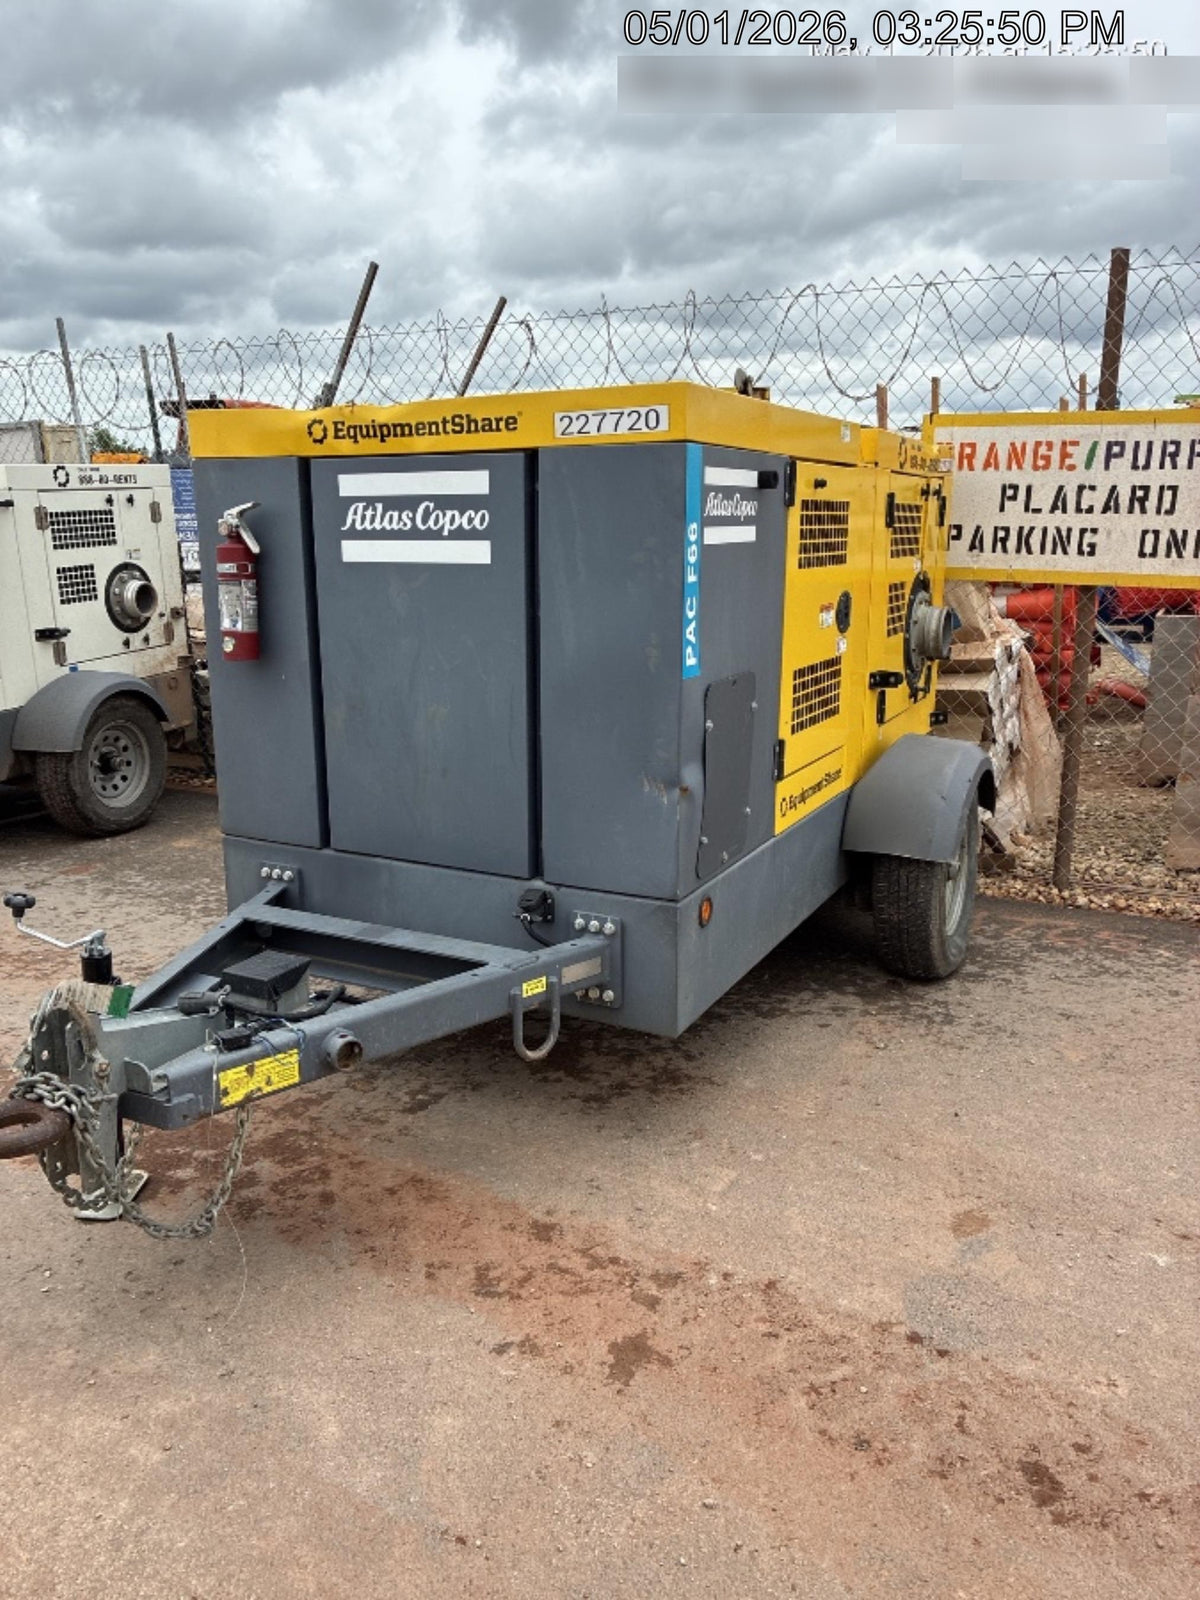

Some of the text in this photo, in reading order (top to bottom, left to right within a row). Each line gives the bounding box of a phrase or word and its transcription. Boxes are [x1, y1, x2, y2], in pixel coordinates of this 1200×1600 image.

[331, 413, 519, 444] EquipmentShare
[559, 408, 660, 436] 227720
[999, 483, 1179, 516] PLACARD
[341, 501, 490, 536] Atlas Copco
[946, 524, 1099, 557] PARKING
[686, 596, 697, 667] PAC
